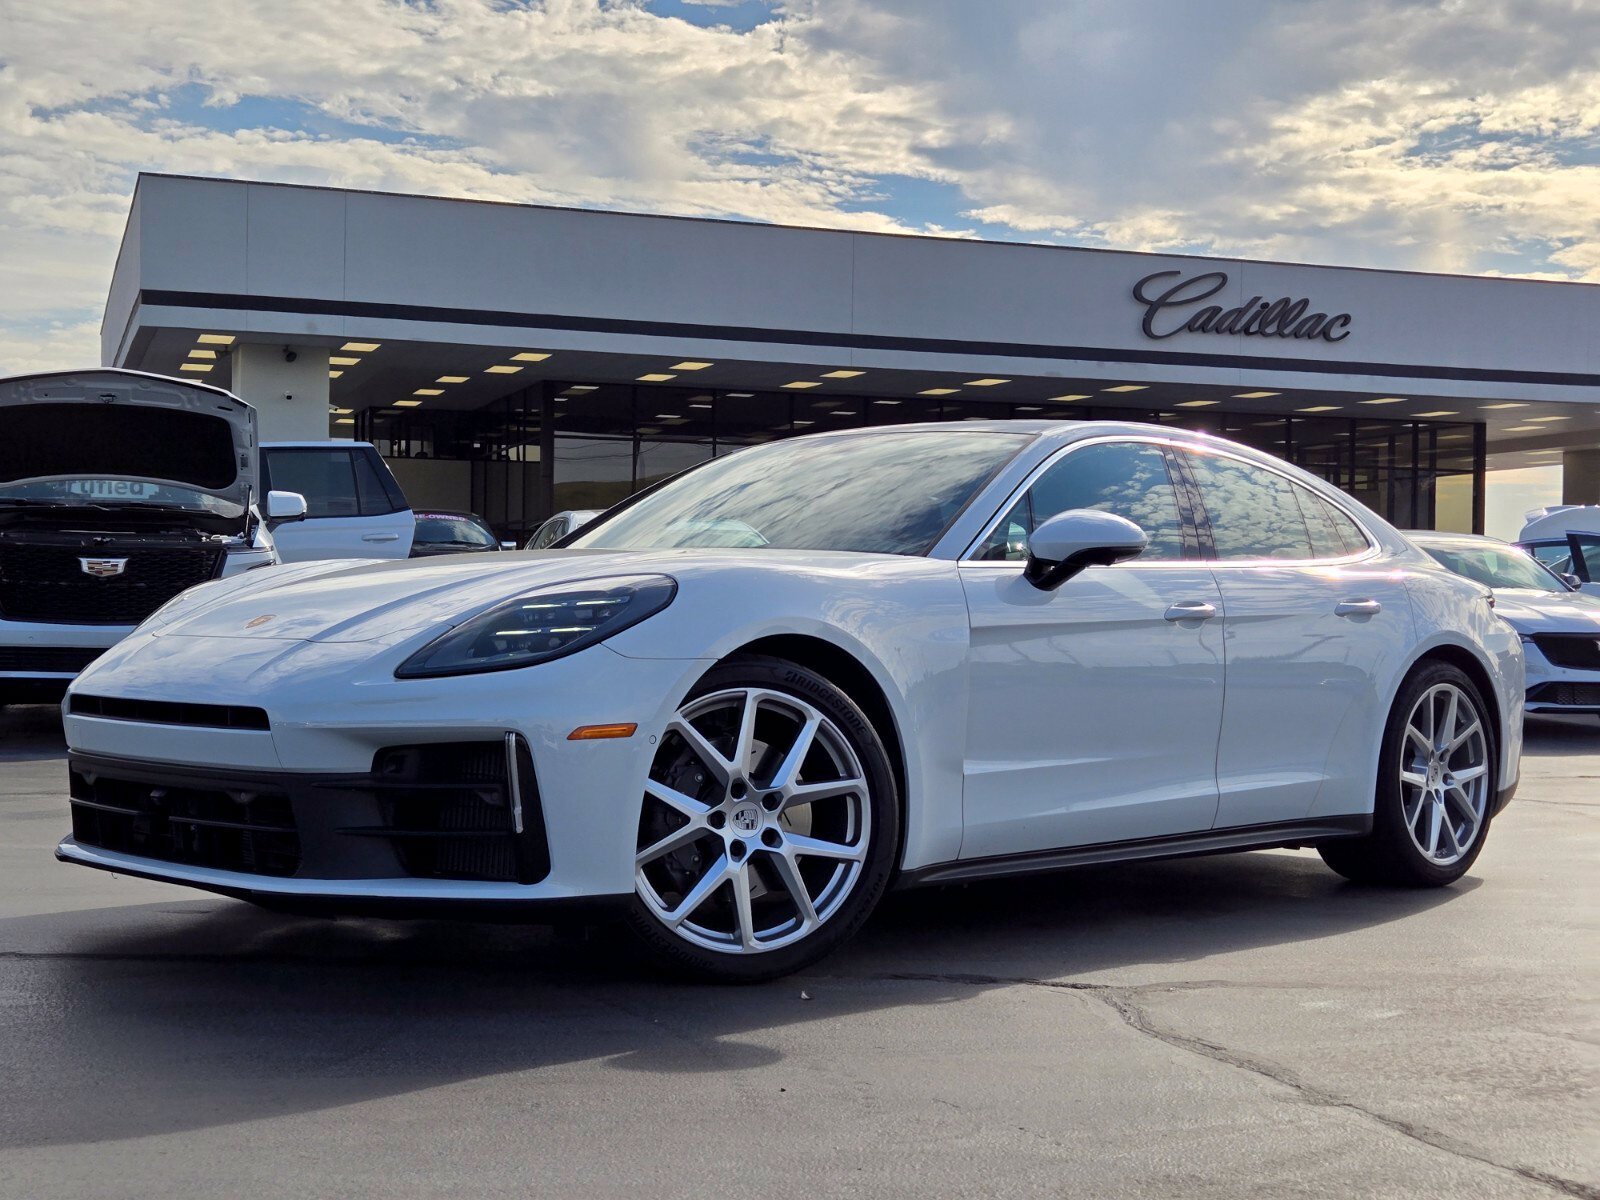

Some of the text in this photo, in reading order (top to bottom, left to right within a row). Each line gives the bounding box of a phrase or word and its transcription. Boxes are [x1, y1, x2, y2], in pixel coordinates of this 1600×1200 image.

[1132, 270, 1352, 342] Cadillac
[68, 480, 144, 496] rtified
[413, 513, 466, 522] RE-OWNED
[784, 670, 867, 736] BRIDGESTONE
